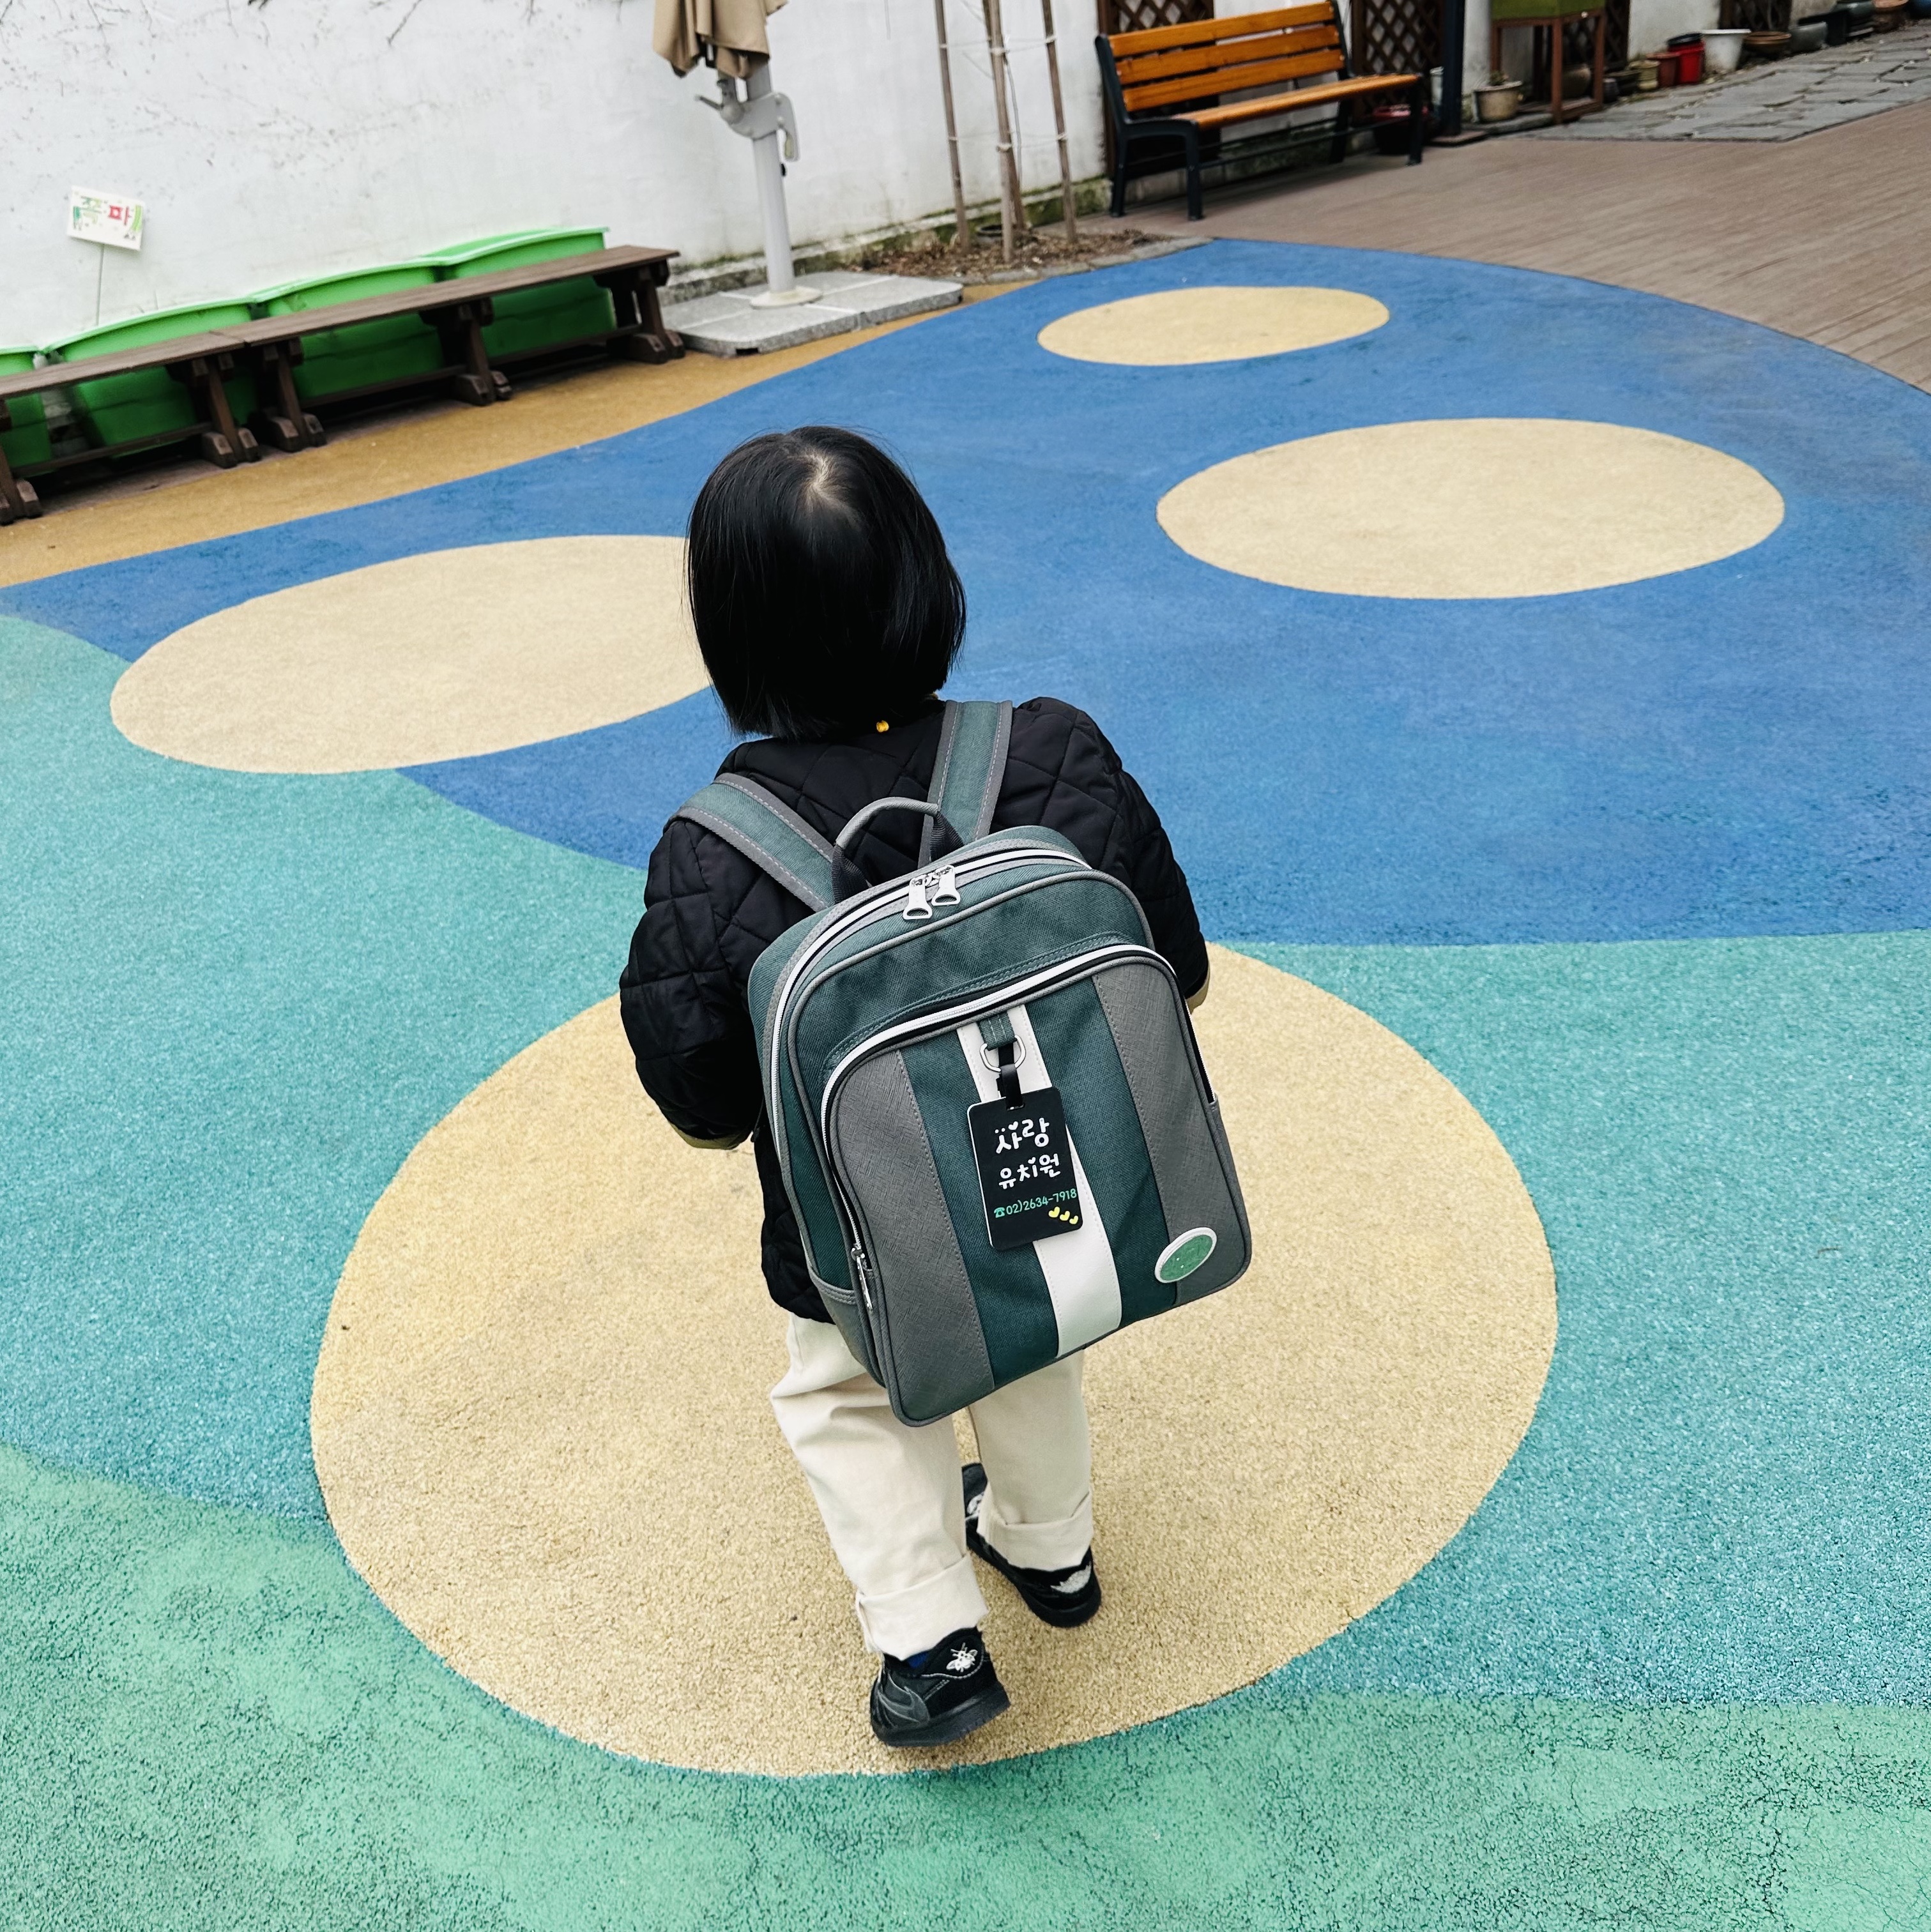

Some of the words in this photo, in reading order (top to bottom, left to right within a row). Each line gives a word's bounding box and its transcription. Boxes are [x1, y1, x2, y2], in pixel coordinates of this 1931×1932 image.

[995, 1118, 1049, 1154] 사랑
[998, 1153, 1061, 1189] 유치원
[1006, 1189, 1077, 1215] 02)2634-7918
